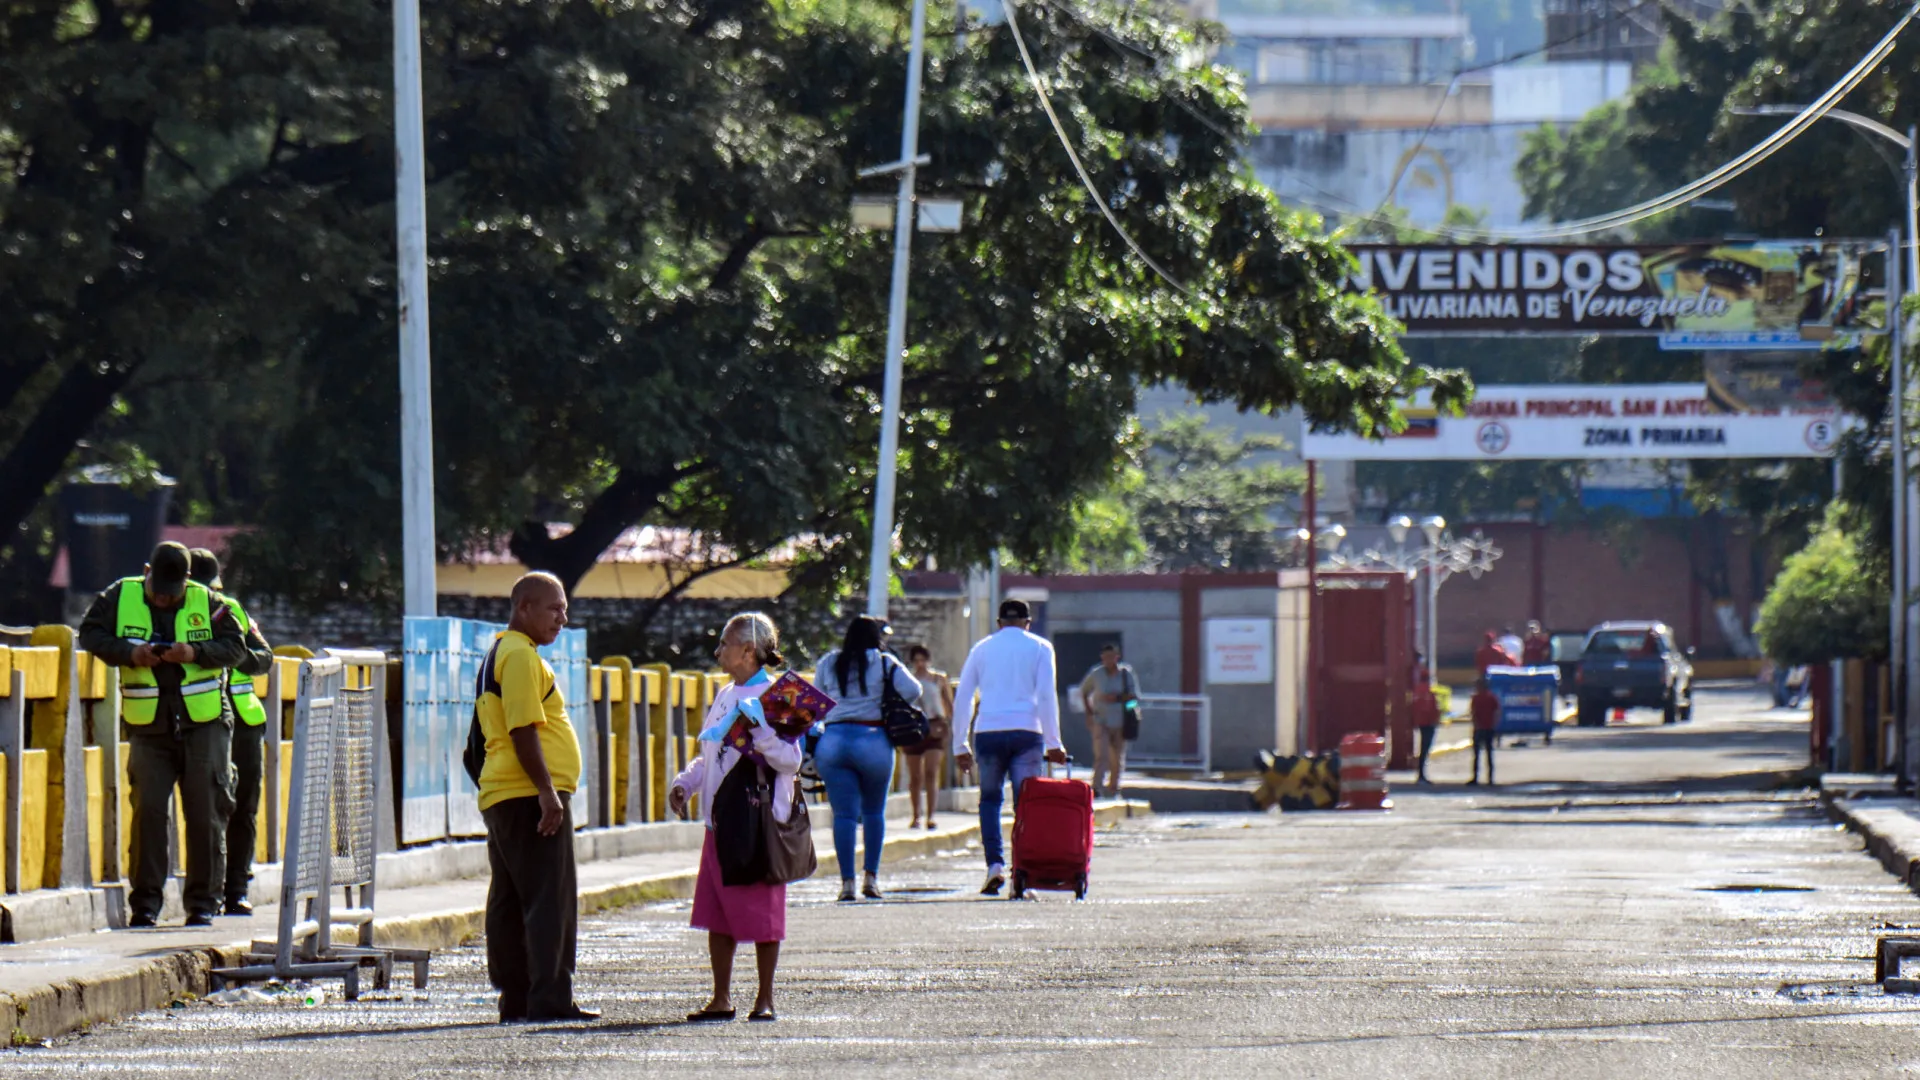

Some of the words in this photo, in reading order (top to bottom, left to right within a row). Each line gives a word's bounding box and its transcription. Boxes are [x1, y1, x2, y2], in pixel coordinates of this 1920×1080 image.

[1527, 293, 1561, 318] DE
[1562, 282, 1730, 328] Venezuela
[1525, 399, 1616, 418] PRINCIPAL
[1621, 399, 1656, 417] SAN
[1584, 427, 1632, 446] ZONA
[1641, 427, 1727, 446] PRIMARIA
